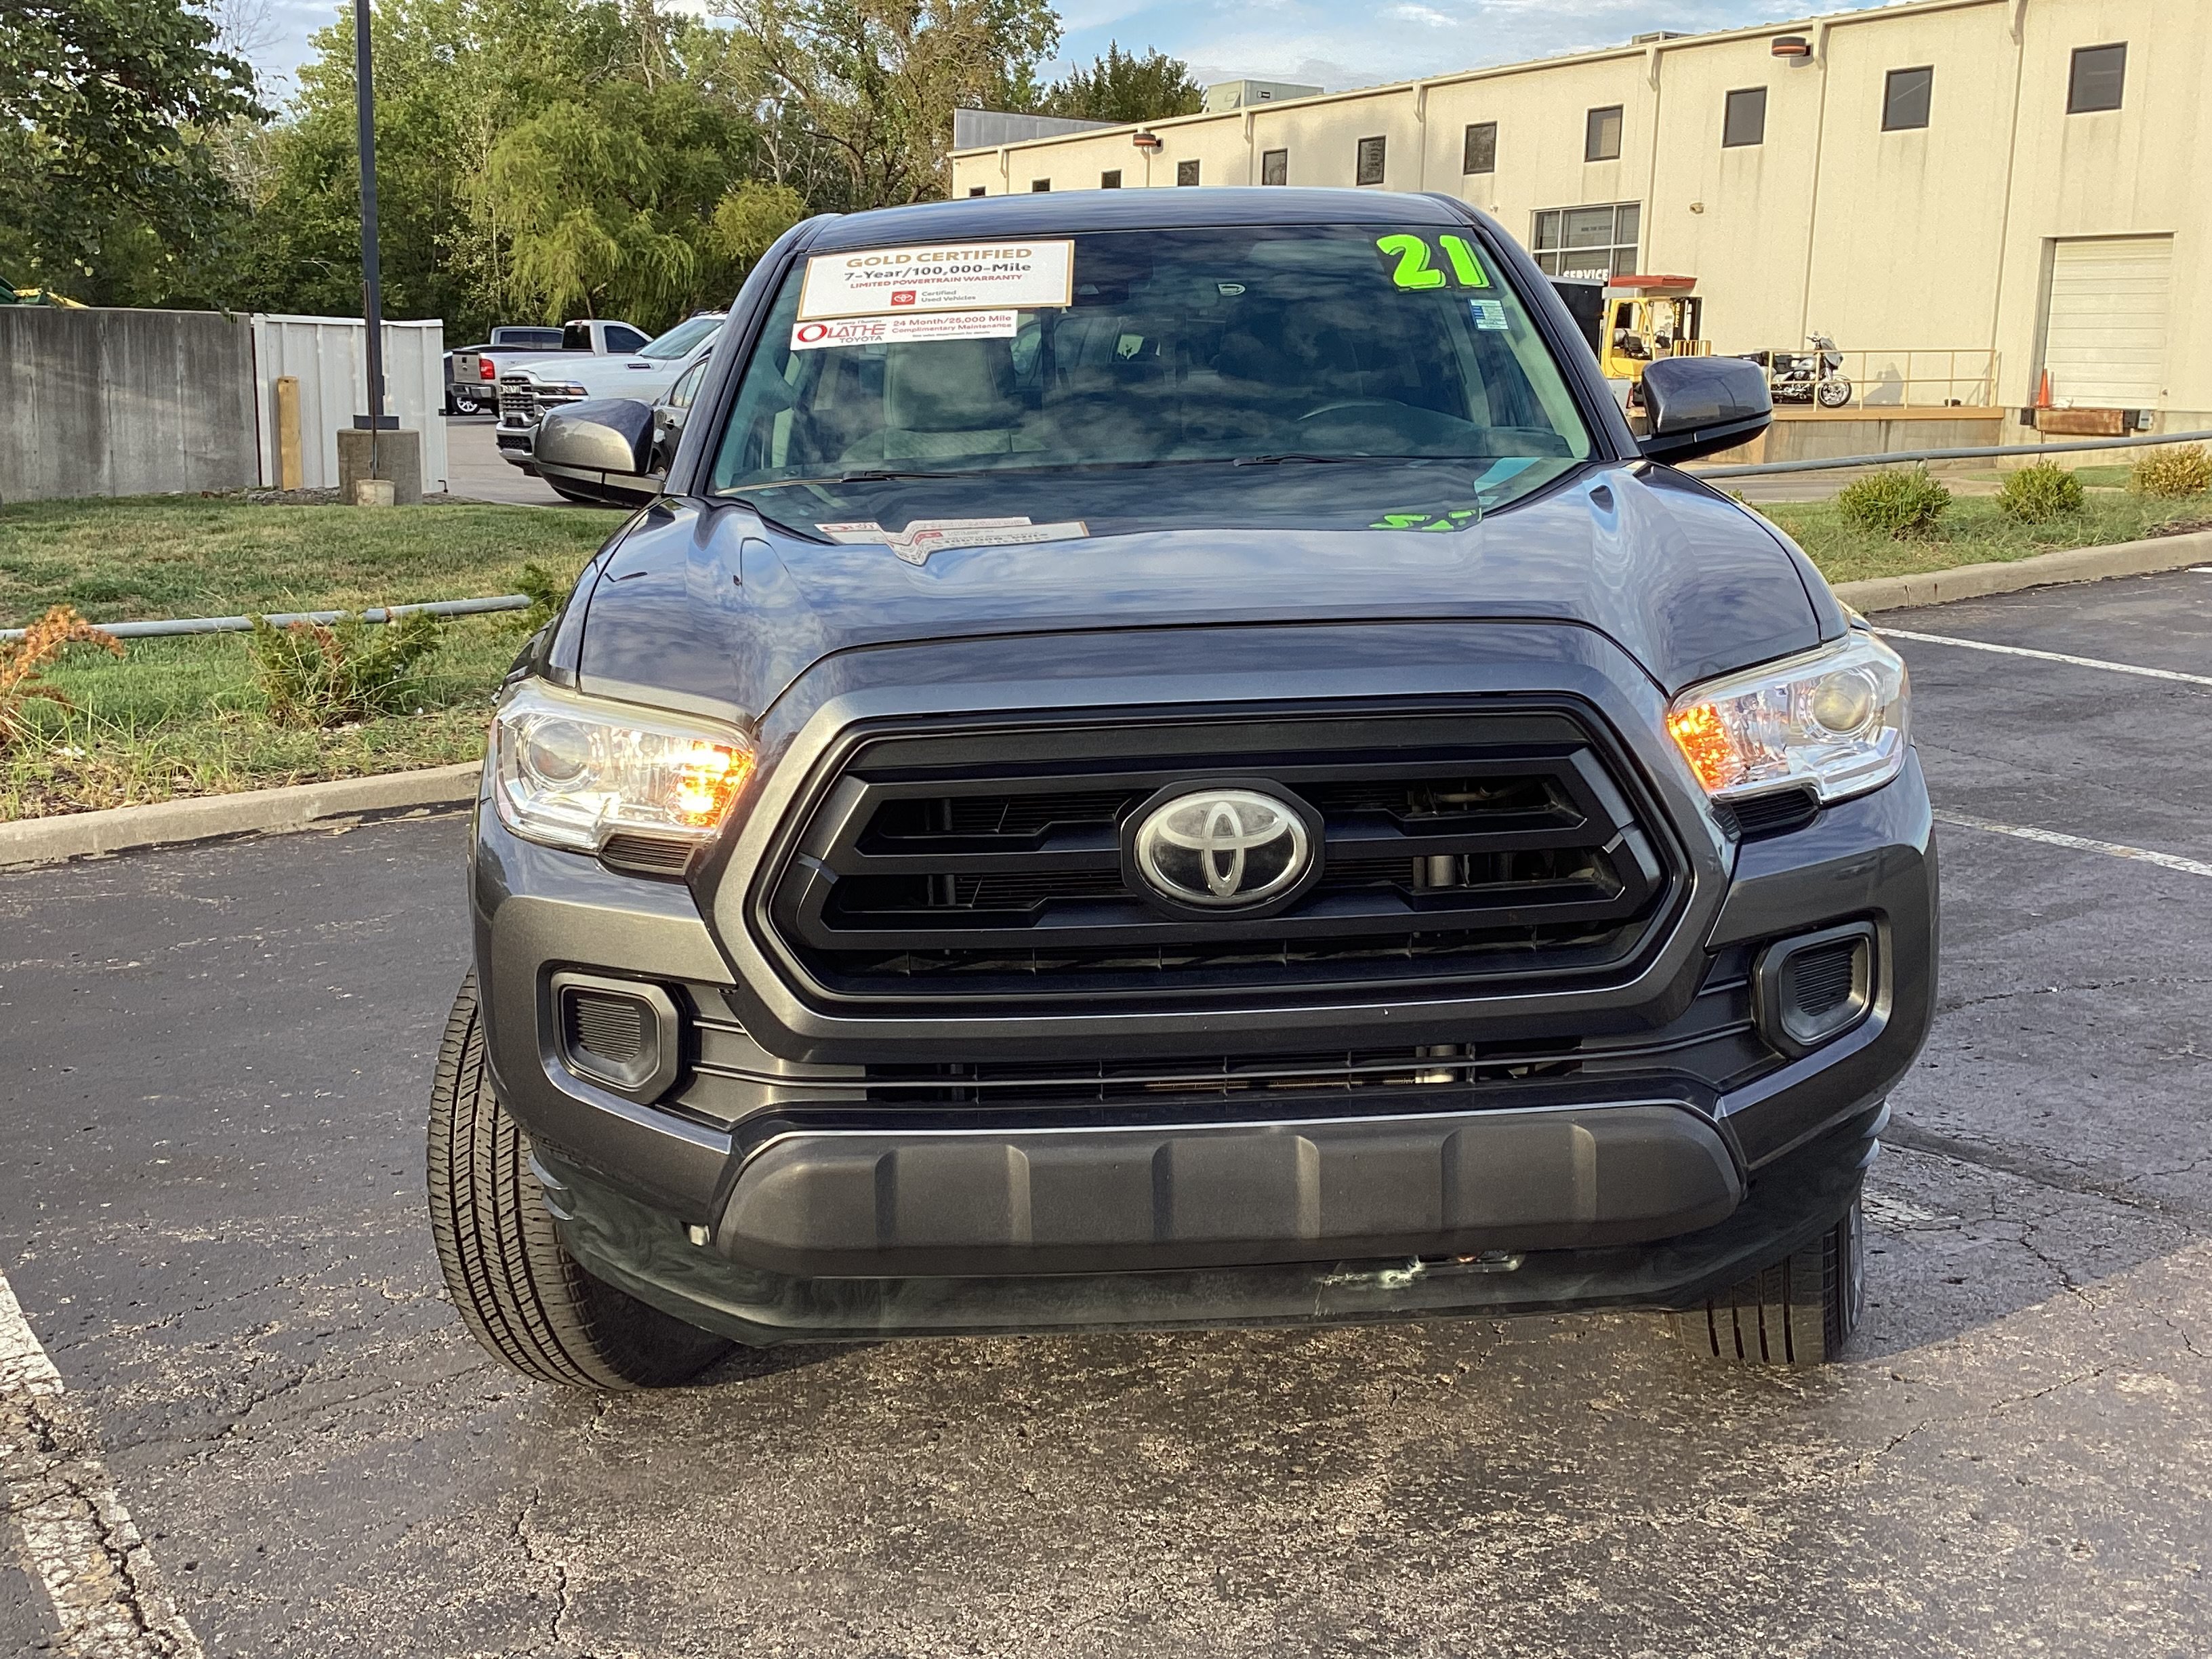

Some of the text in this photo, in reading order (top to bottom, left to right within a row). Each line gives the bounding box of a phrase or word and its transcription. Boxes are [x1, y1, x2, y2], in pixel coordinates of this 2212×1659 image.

[846, 248, 1032, 268] GOLD CERTIFIED
[1376, 234, 1490, 289] 21
[844, 262, 1031, 281] 7-Year/100,000-Mile
[850, 274, 1023, 289] LIMITED POWERTRAIN WARRANTY
[797, 323, 887, 342] OLATHE
[892, 325, 956, 333] Complimentary
